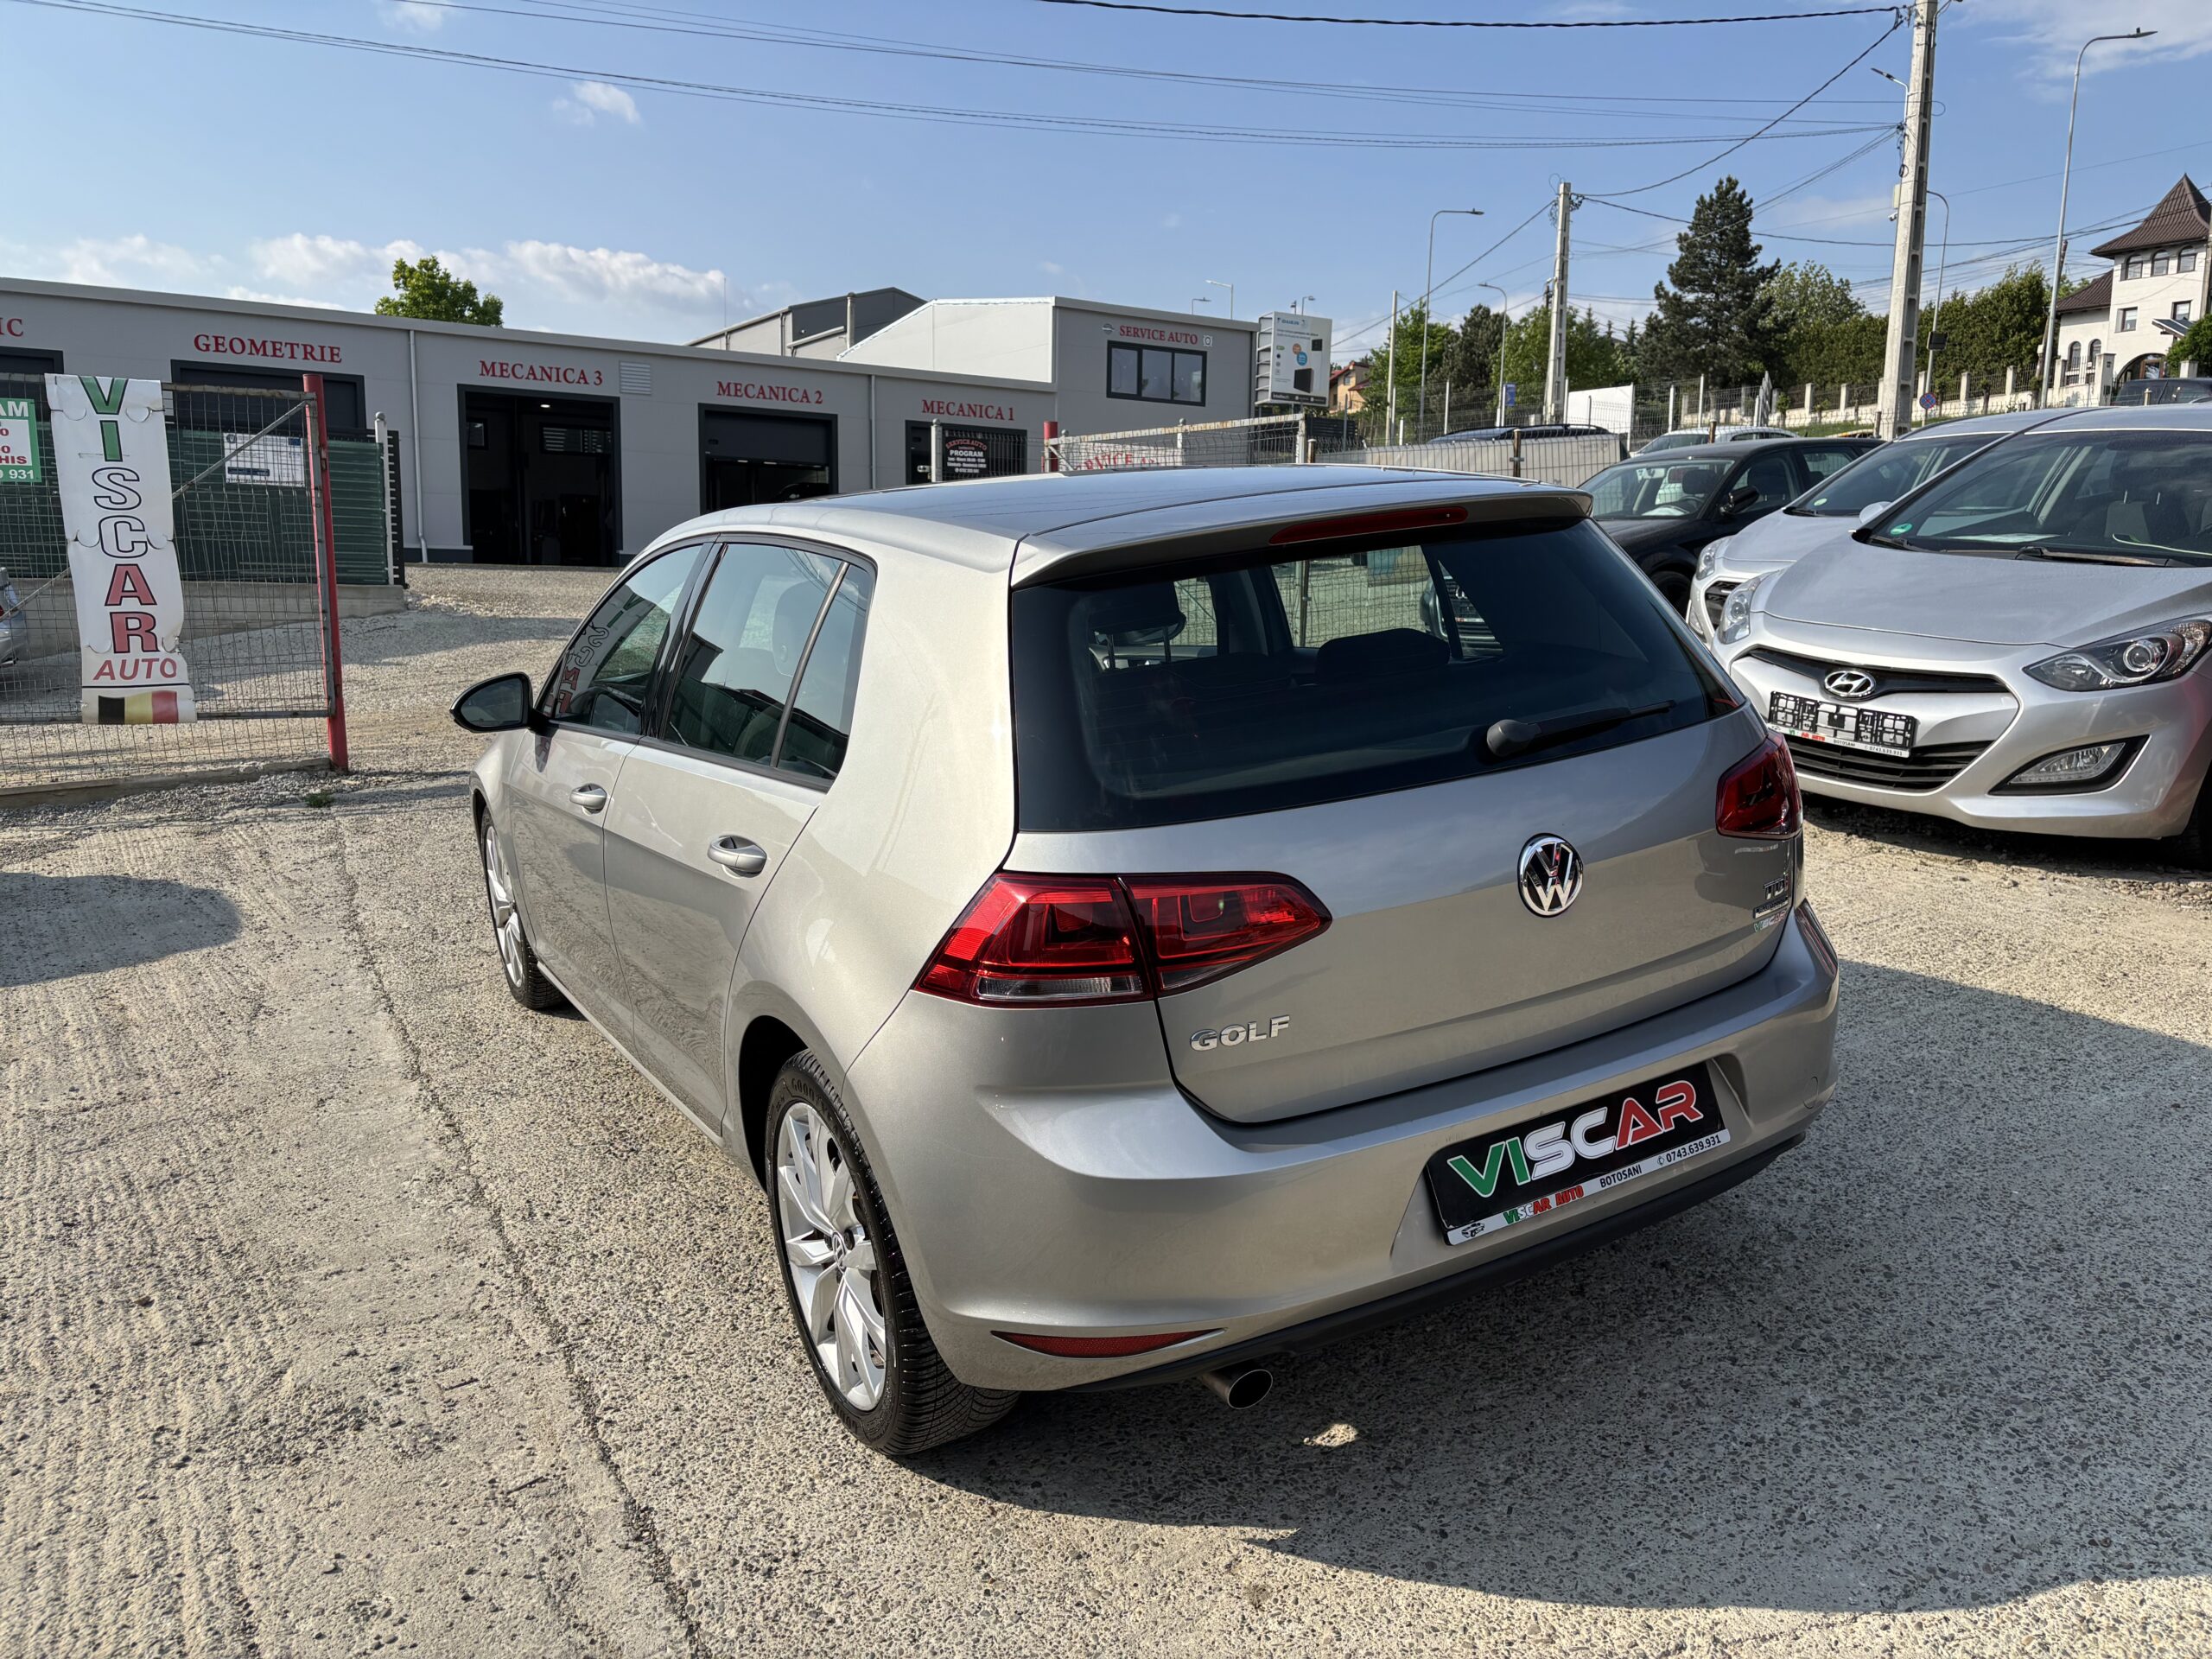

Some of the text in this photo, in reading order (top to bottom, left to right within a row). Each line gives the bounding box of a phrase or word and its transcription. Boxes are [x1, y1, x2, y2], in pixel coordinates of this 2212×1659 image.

[1119, 325, 1198, 345] SERVICE AUTO
[194, 334, 342, 364] GEOMETRIE
[479, 359, 603, 386] MECANICA 3
[716, 381, 823, 404] MECANICA 2
[921, 399, 1014, 421] MECANICA 1
[949, 449, 984, 458] PROGRAM
[9, 469, 35, 480] 931
[78, 376, 160, 654] VISCAR
[92, 658, 178, 682] AUTO
[1190, 1014, 1290, 1052] GOLF
[1446, 1080, 1704, 1198] VISCAR
[1503, 1135, 1722, 1225] VISCAR AUTO BOTOSANI 0743.639.931
